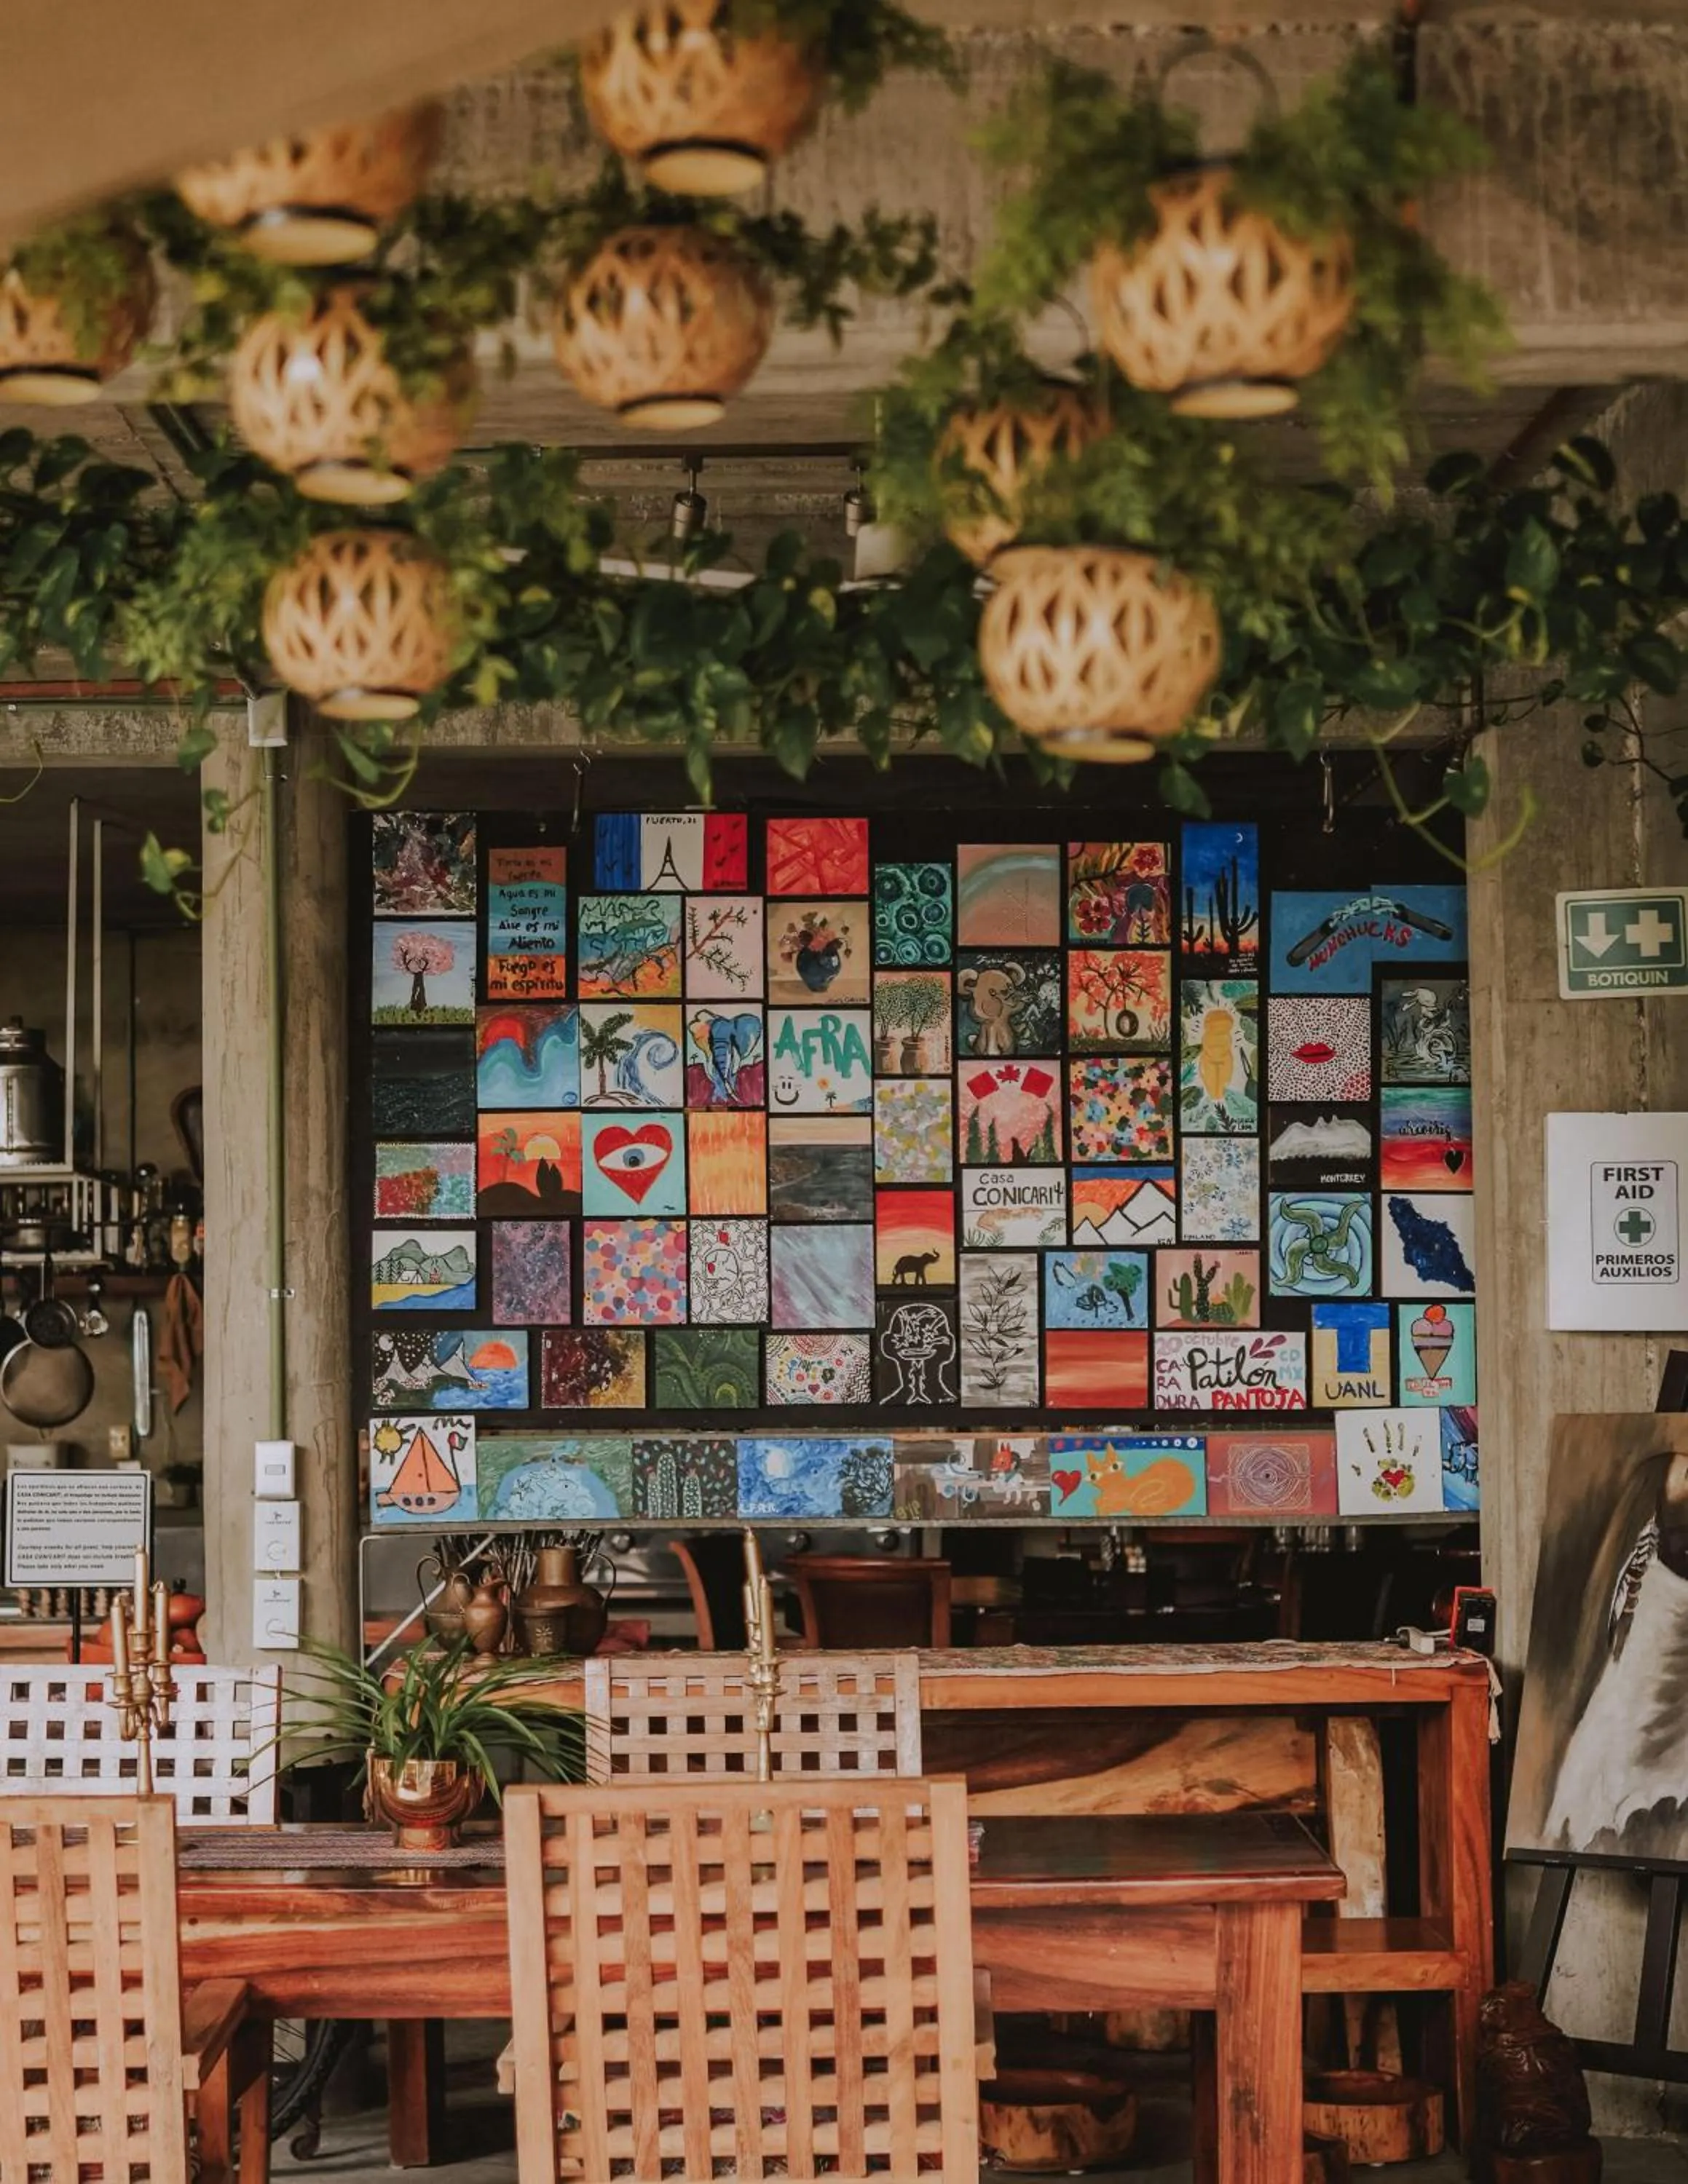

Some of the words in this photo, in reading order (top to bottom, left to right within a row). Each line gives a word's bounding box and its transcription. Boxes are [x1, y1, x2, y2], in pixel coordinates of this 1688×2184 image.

[498, 959, 536, 978] Fuego
[490, 977, 508, 990] mi
[1588, 970, 1669, 986] BOTIQUIN
[773, 1014, 872, 1078] AFRA
[979, 1173, 1014, 1184] Casa
[1604, 1167, 1665, 1182] FIRST
[1614, 1185, 1655, 1199] AID
[1596, 1254, 1676, 1265] PRIMEROS
[1599, 1267, 1672, 1278] AUXILIOS
[1279, 1349, 1301, 1362] CD
[1157, 1376, 1181, 1391] RA
[1325, 1380, 1386, 1400] UANL
[1156, 1393, 1201, 1409] DURA
[1211, 1386, 1306, 1410] PANTOJA
